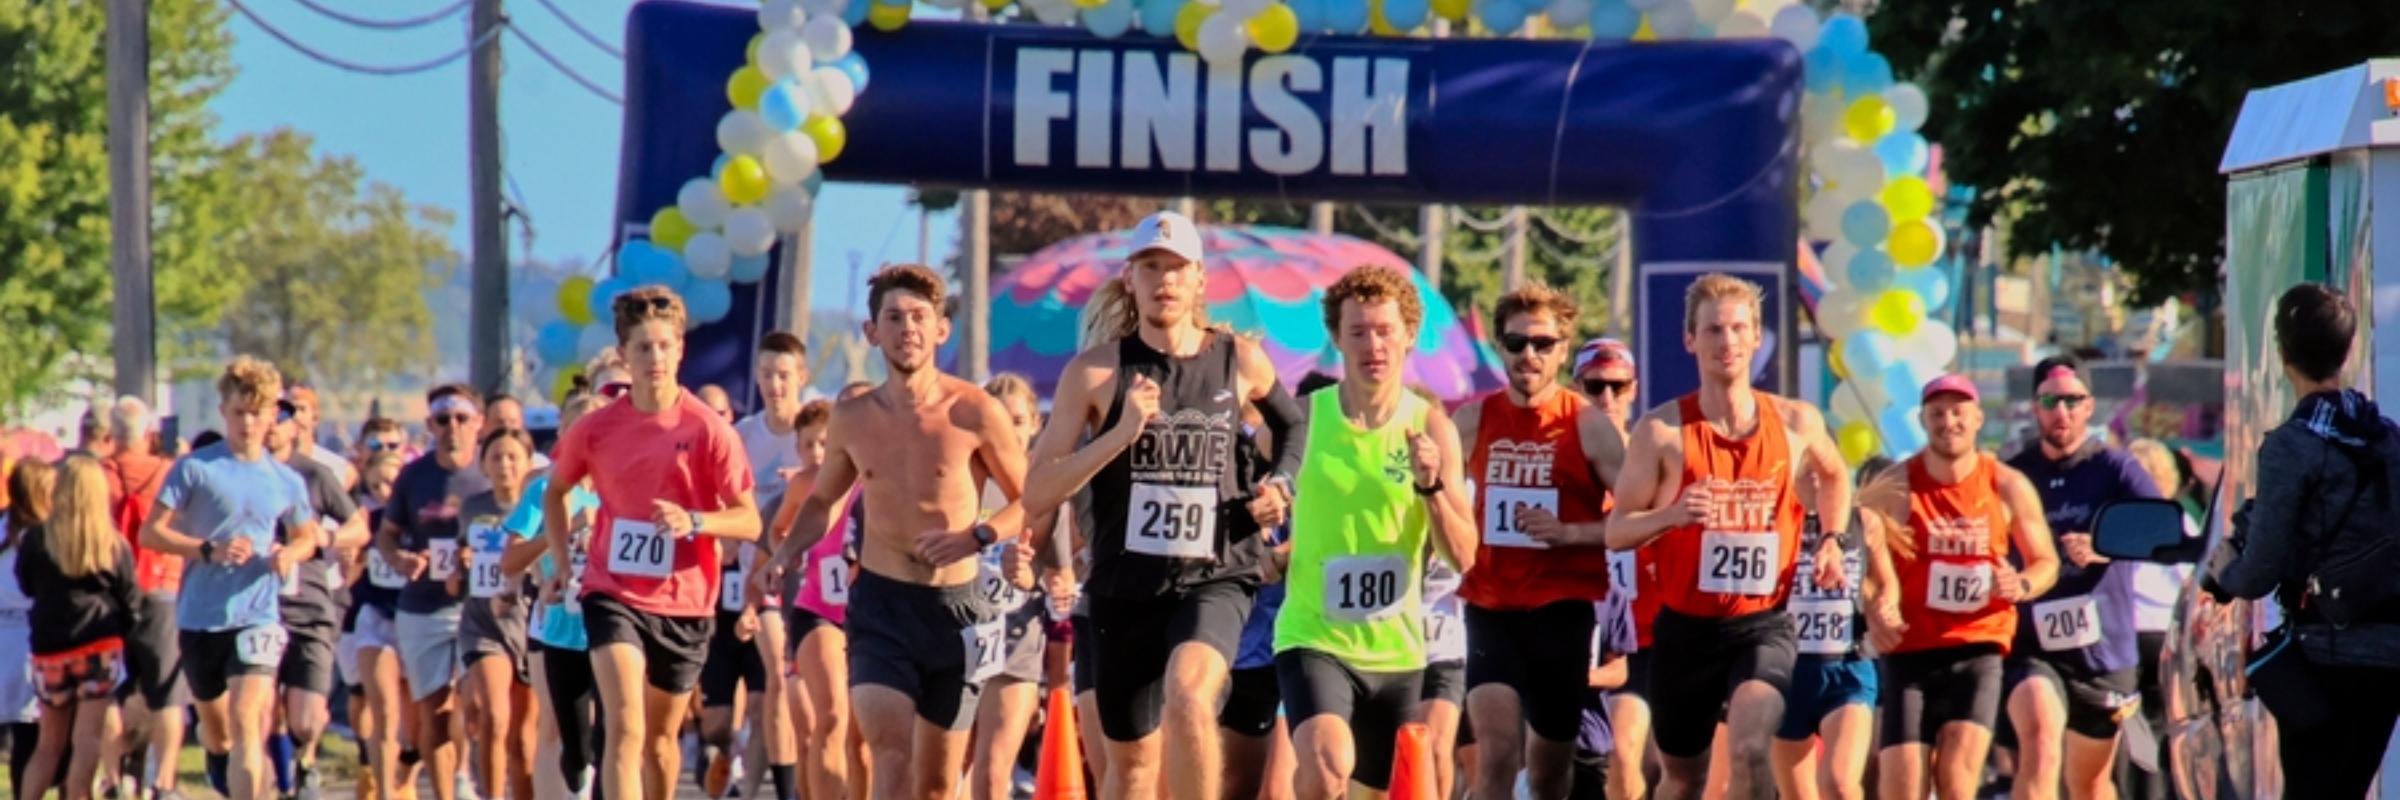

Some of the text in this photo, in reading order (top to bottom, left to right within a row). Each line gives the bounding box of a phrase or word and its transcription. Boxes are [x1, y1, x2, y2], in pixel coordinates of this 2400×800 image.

[1014, 48, 1409, 174] FINISH
[1130, 429, 1228, 471] RWE
[1485, 460, 1553, 486] ELITE
[1140, 500, 1204, 542] 259
[618, 531, 665, 566] 270
[1711, 544, 1768, 580] 256
[1338, 570, 1397, 609] 180
[1938, 575, 1983, 603] 162
[1797, 612, 1844, 641] 258
[2044, 607, 2089, 638] 204
